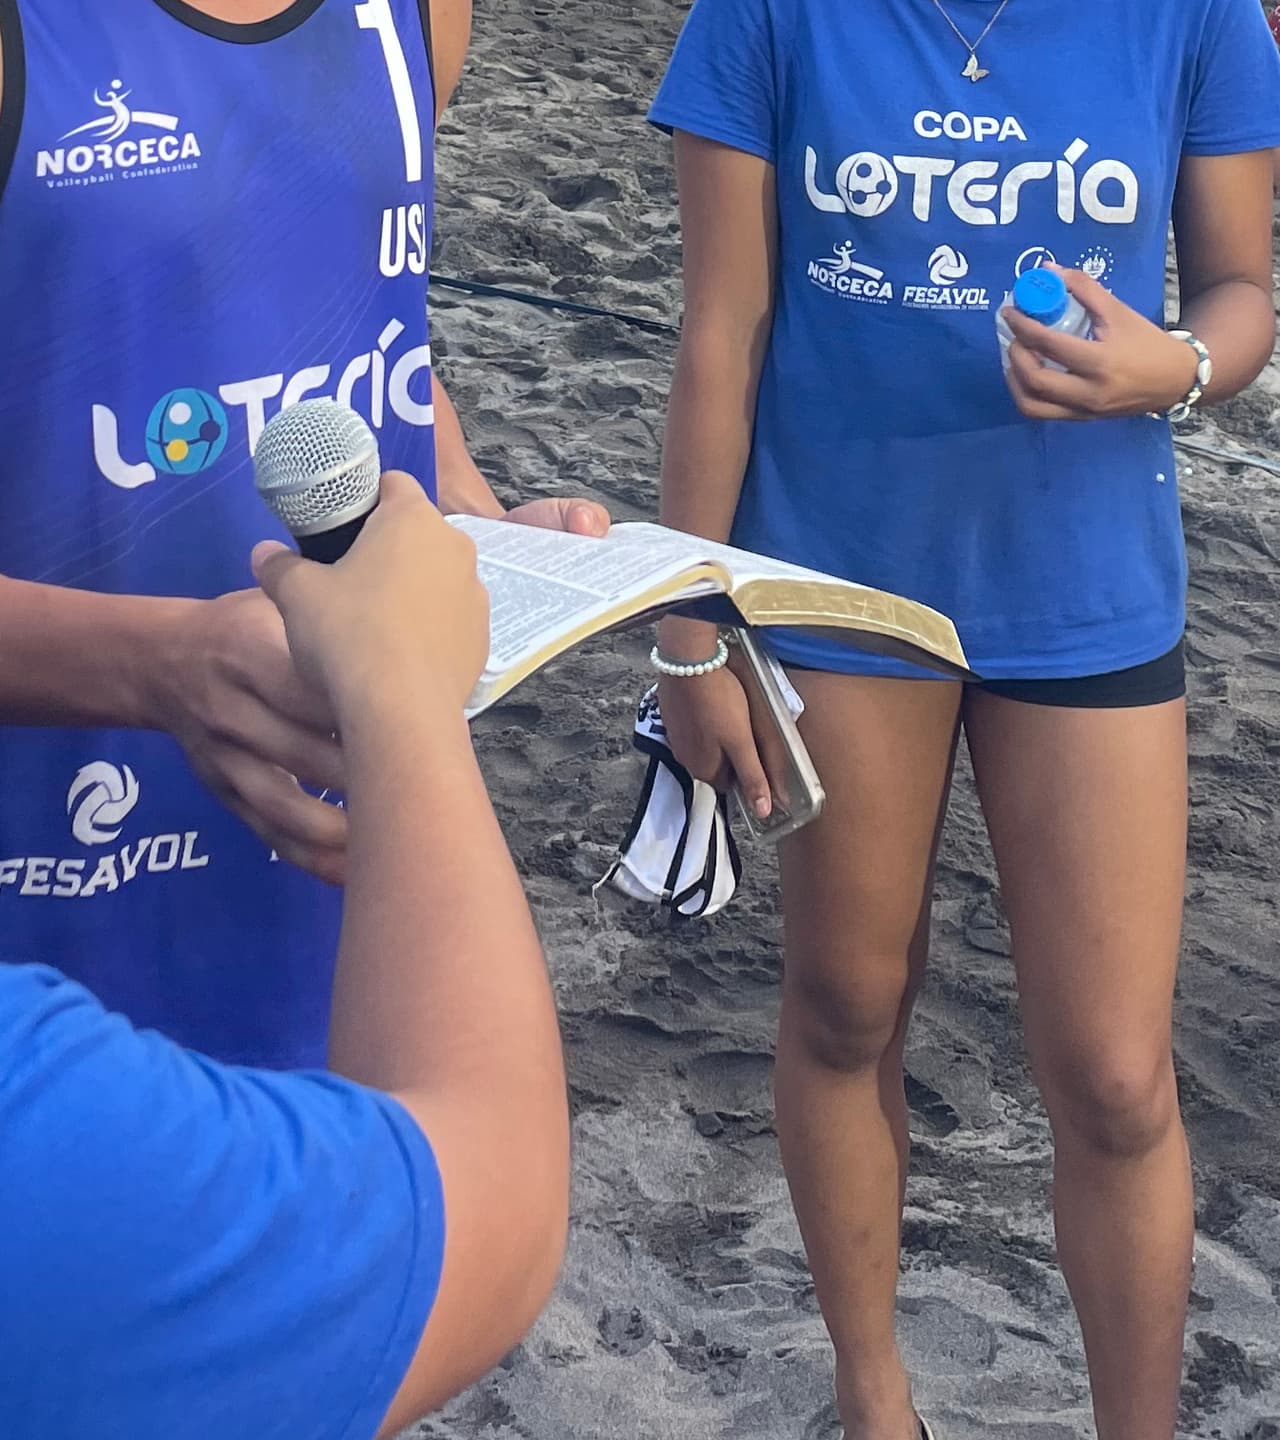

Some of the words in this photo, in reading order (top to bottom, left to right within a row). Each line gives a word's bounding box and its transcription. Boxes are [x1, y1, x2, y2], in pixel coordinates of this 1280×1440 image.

[913, 109, 1028, 142] COPA
[36, 132, 202, 177] NORCECA
[47, 173, 114, 189] Volleyball
[379, 202, 426, 277] US
[807, 260, 894, 299] NORCECA
[902, 286, 990, 306] FESAVOL
